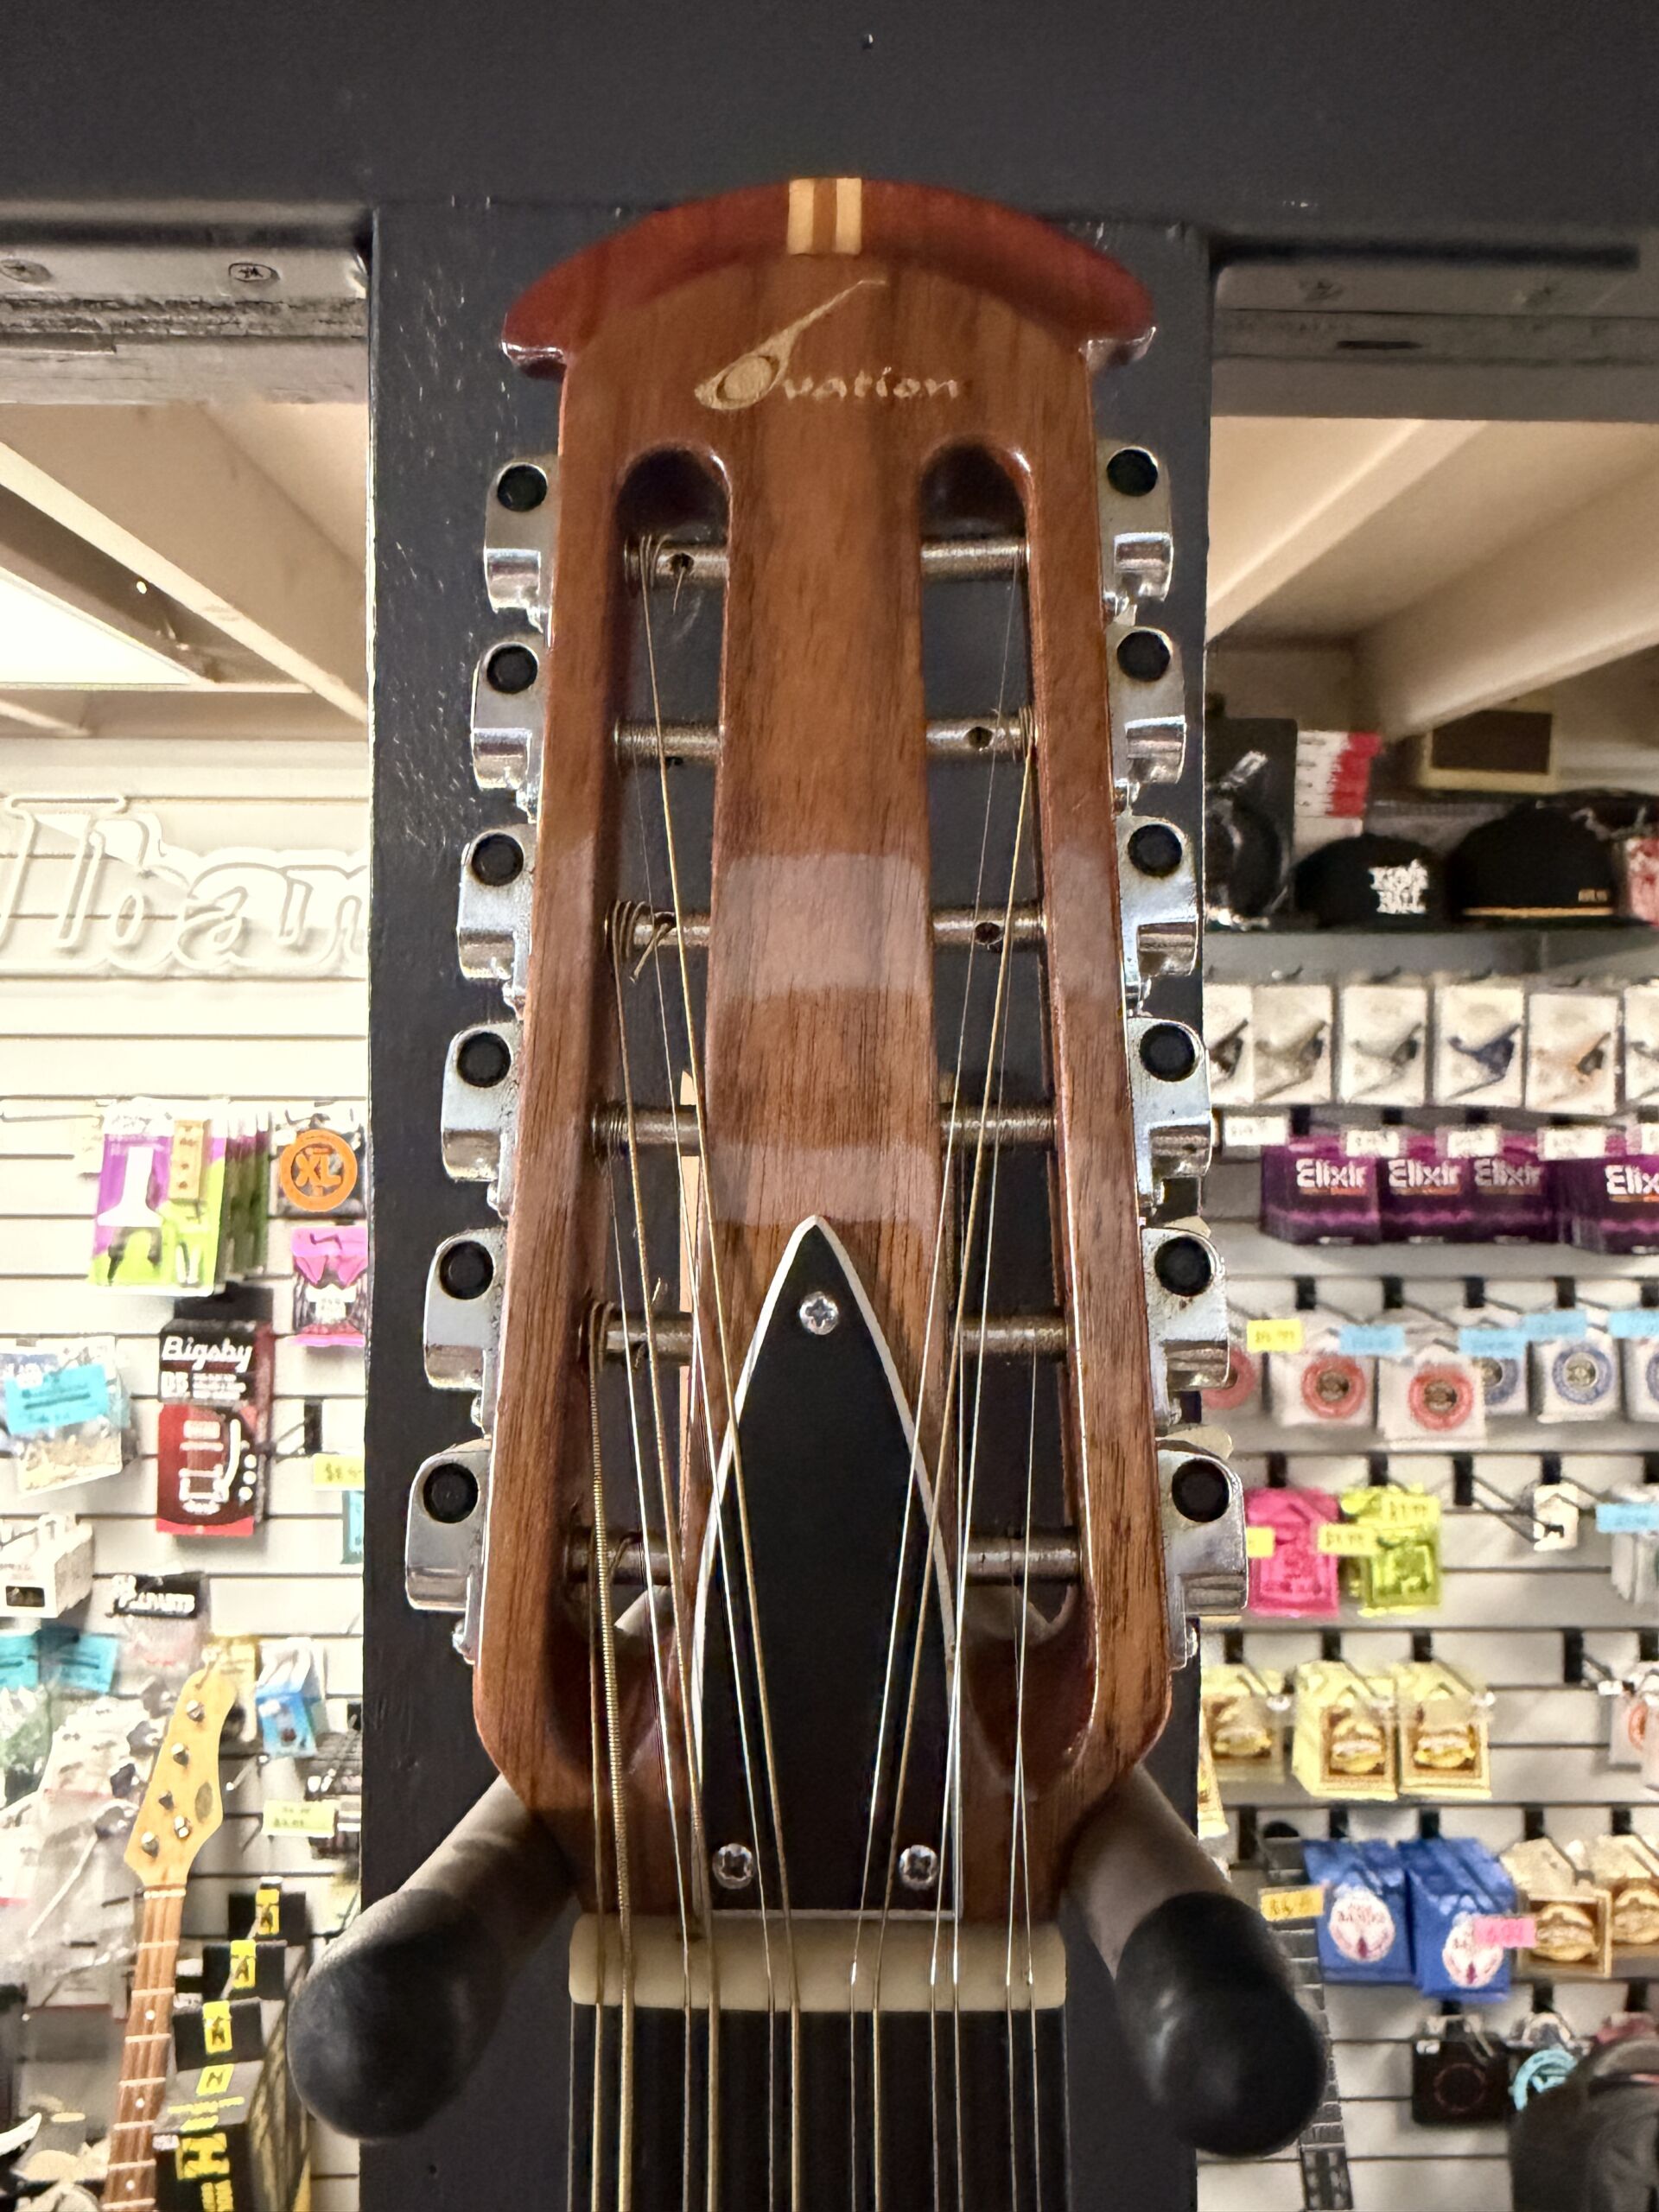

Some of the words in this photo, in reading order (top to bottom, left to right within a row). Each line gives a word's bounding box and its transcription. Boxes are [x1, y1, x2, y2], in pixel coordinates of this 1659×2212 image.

[694, 279, 959, 410] Ovation
[1295, 1158, 1366, 1188] Elixir
[1388, 1158, 1462, 1187] Elixir
[1473, 1158, 1542, 1187] Elixir
[1605, 1164, 1659, 1195] Elix
[161, 1335, 253, 1373] Bigsby
